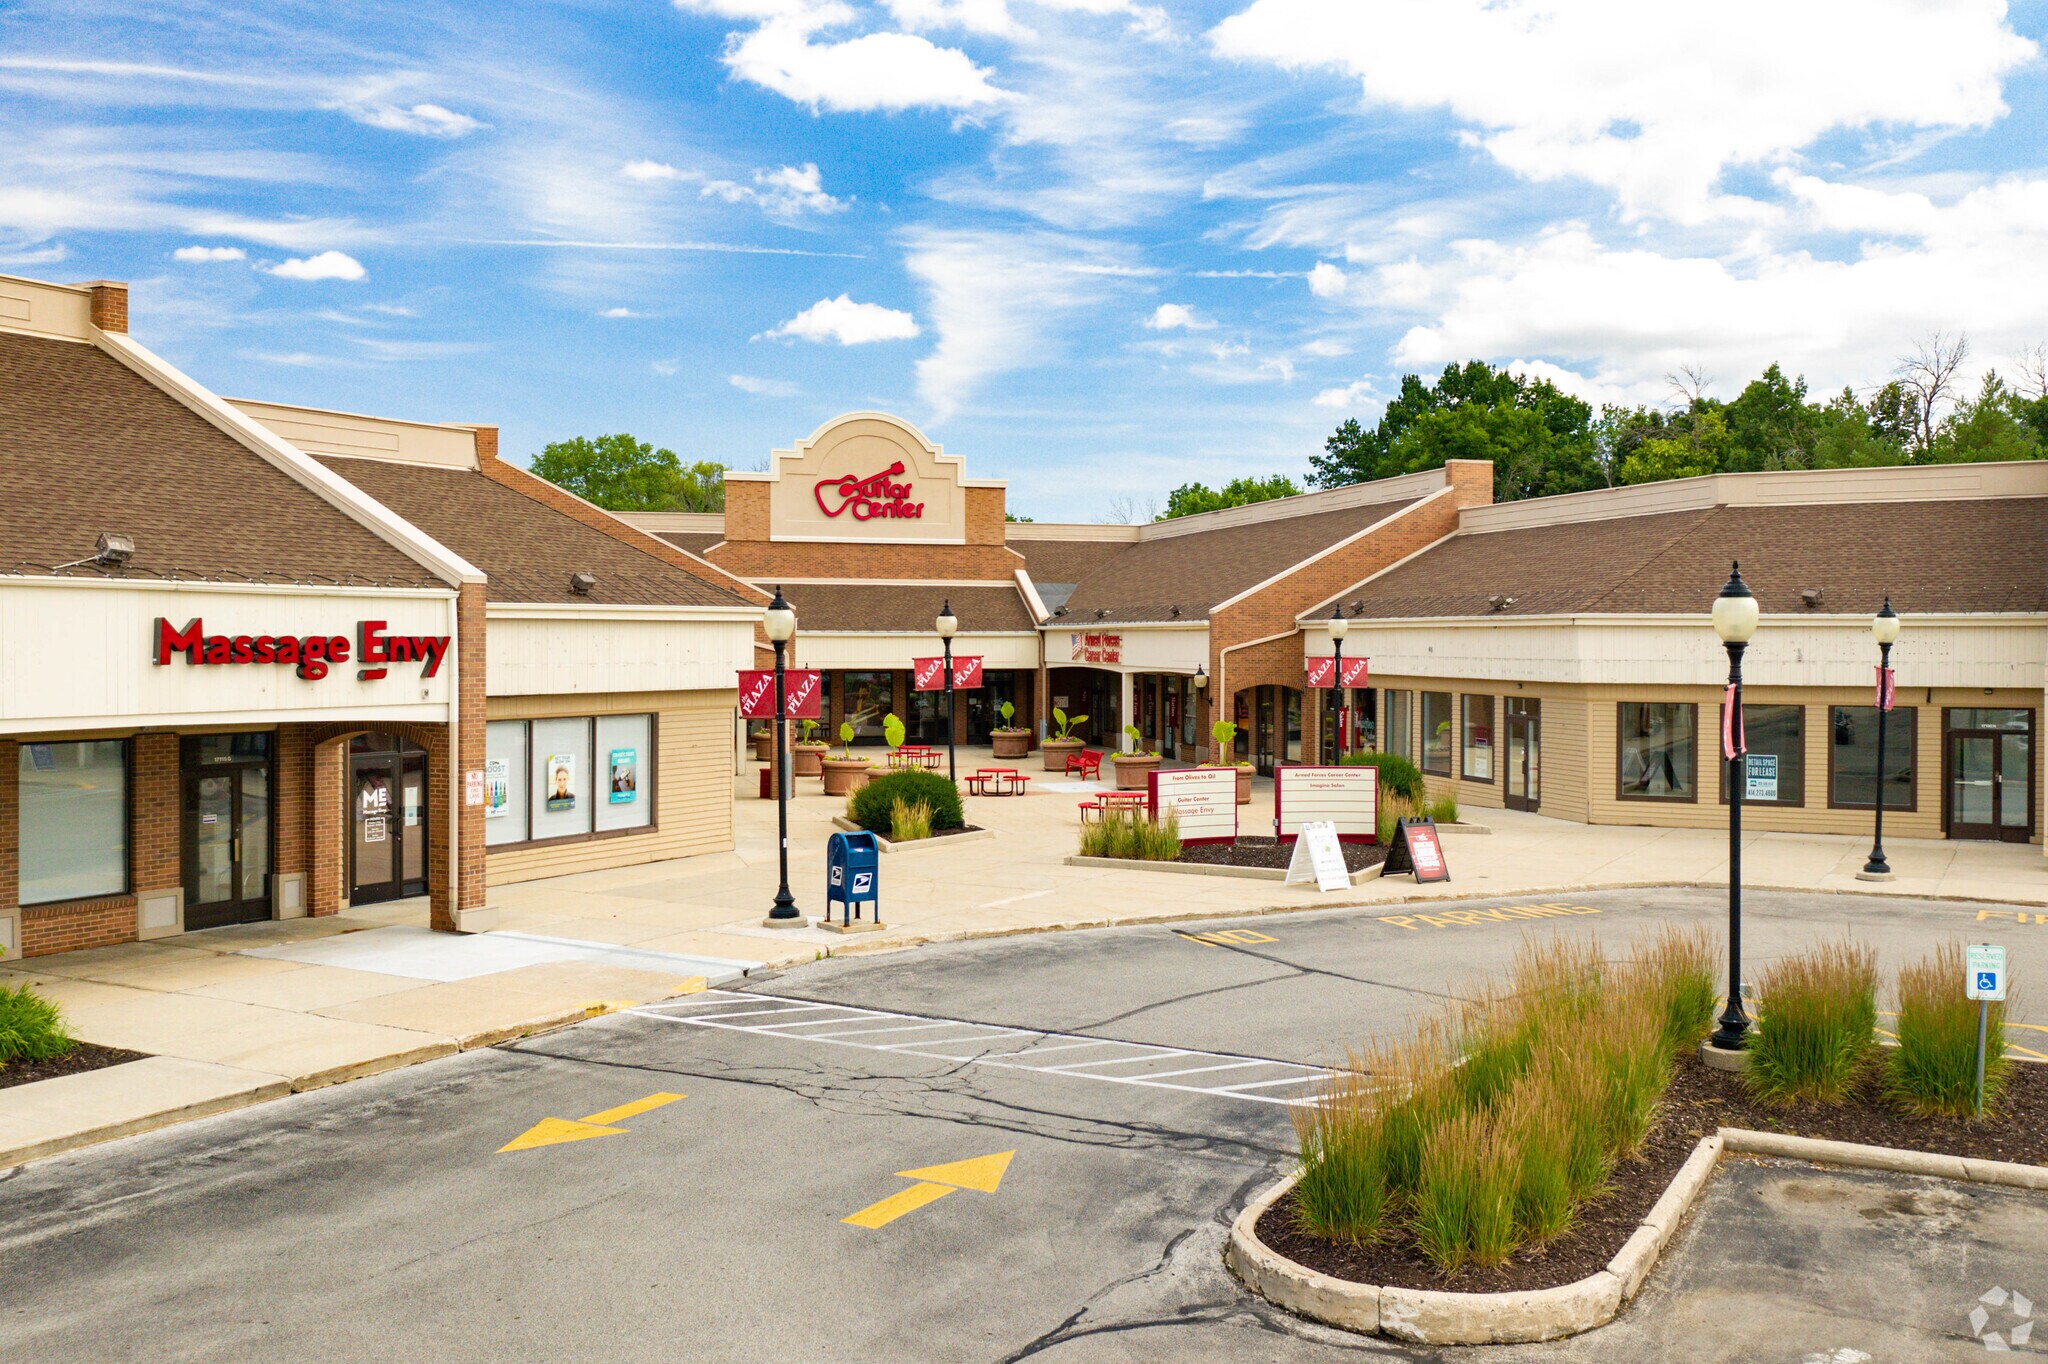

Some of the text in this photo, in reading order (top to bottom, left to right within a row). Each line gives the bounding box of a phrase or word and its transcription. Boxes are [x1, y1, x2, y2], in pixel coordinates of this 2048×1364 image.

[815, 461, 912, 517] Guitar
[852, 499, 924, 521] Center
[153, 617, 451, 681] Massage Envy
[1085, 632, 1120, 647] Armed Forces
[1085, 647, 1119, 663] Career Center
[917, 660, 942, 688] PLAZA
[955, 658, 980, 686] PLAZA
[1309, 659, 1333, 685] PLAZA
[1343, 659, 1366, 685] PLAZA
[743, 674, 773, 714] PLAZA
[787, 674, 819, 714] PLAZA
[486, 765, 506, 773] OOST
[1748, 758, 1762, 766] RETAIL
[1748, 766, 1776, 777] FOR LEASE
[363, 787, 387, 809] ME
[1376, 902, 1603, 931] PARKING
[1178, 929, 1280, 948] NO
[1972, 961, 2001, 969] PARKING
